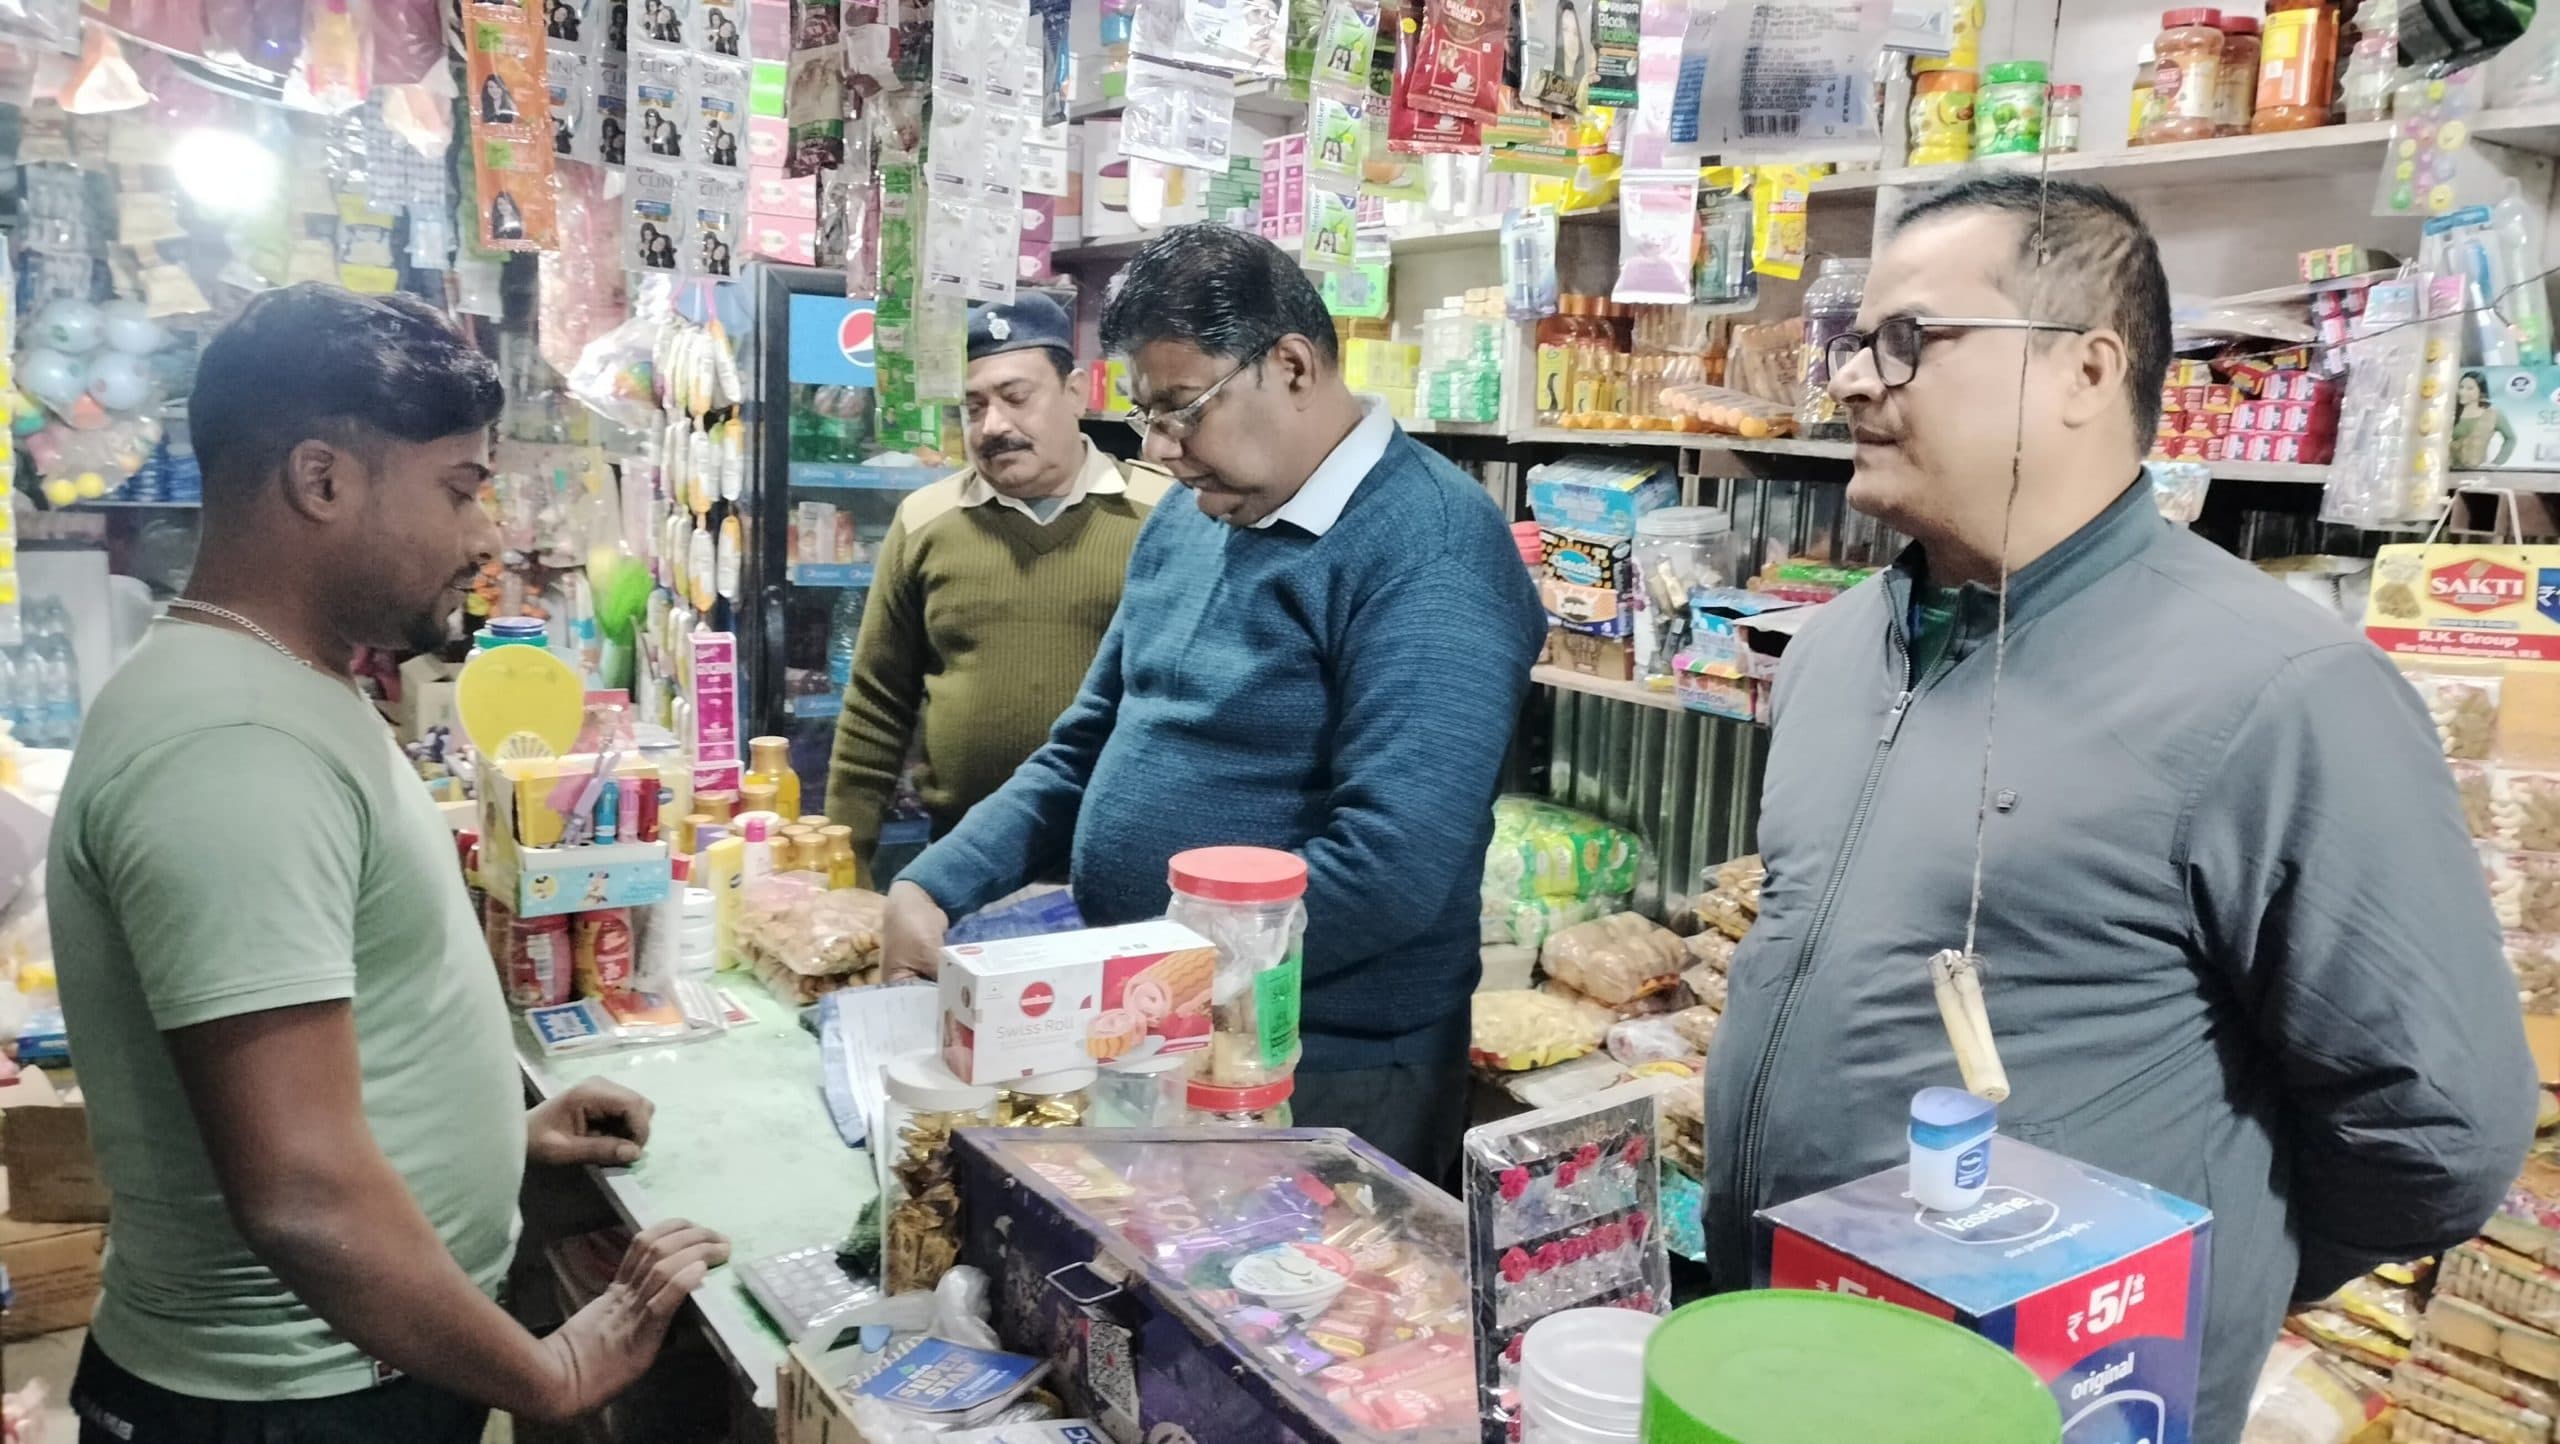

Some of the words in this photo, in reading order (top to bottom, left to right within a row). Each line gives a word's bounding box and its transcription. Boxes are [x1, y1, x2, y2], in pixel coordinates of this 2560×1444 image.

[1362, 14, 1373, 25] 7
[1351, 106, 1360, 118] 7
[1346, 199, 1355, 210] 7
[2431, 577, 2524, 595] SAKTI
[2459, 633, 2519, 649] Group
[996, 1022, 1041, 1040] Swiss
[1044, 1017, 1075, 1034] Roll
[1935, 1197, 2033, 1233] Vaseline
[899, 1352, 972, 1398] SUPER
[925, 1362, 979, 1398] STAR
[2070, 1352, 2136, 1401] original
